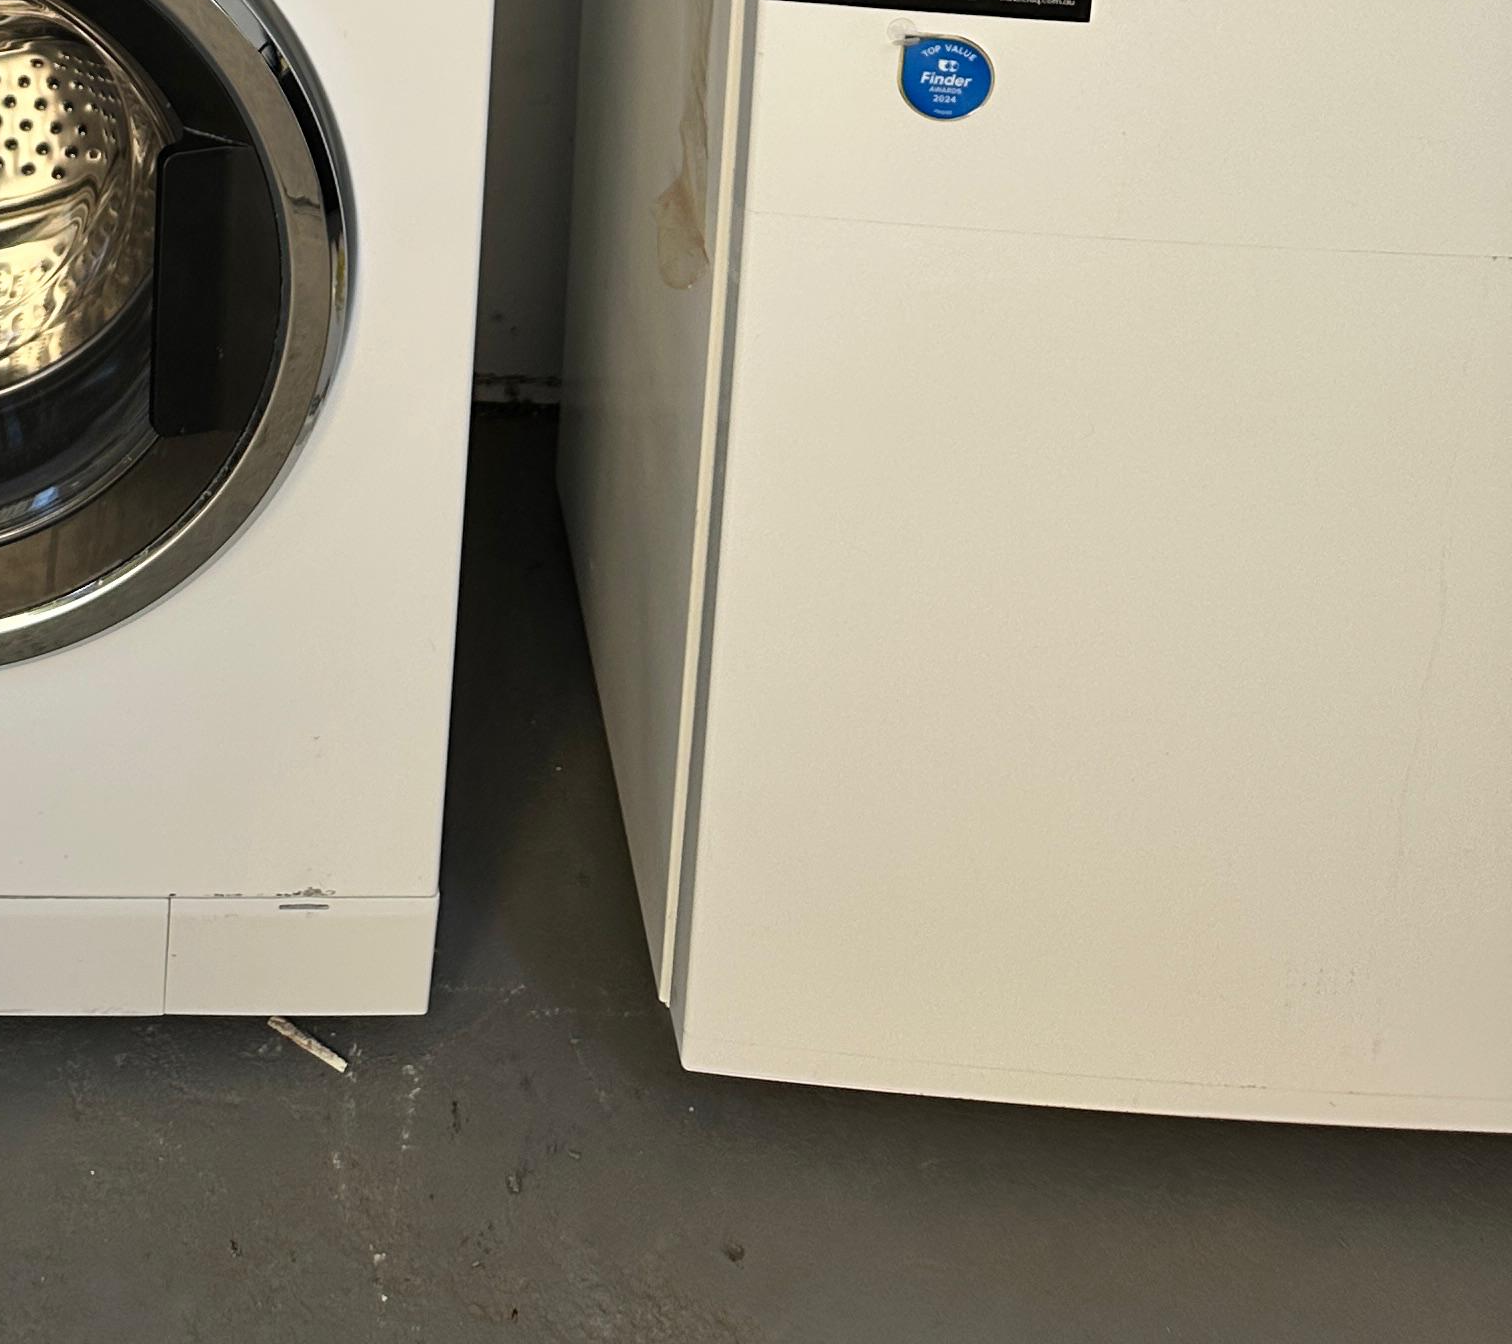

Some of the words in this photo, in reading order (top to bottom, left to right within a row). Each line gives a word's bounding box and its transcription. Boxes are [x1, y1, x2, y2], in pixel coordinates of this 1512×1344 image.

[921, 45, 941, 56] TOP
[945, 44, 977, 61] VALUE
[921, 70, 972, 89] Finder
[933, 95, 956, 103] 2024
